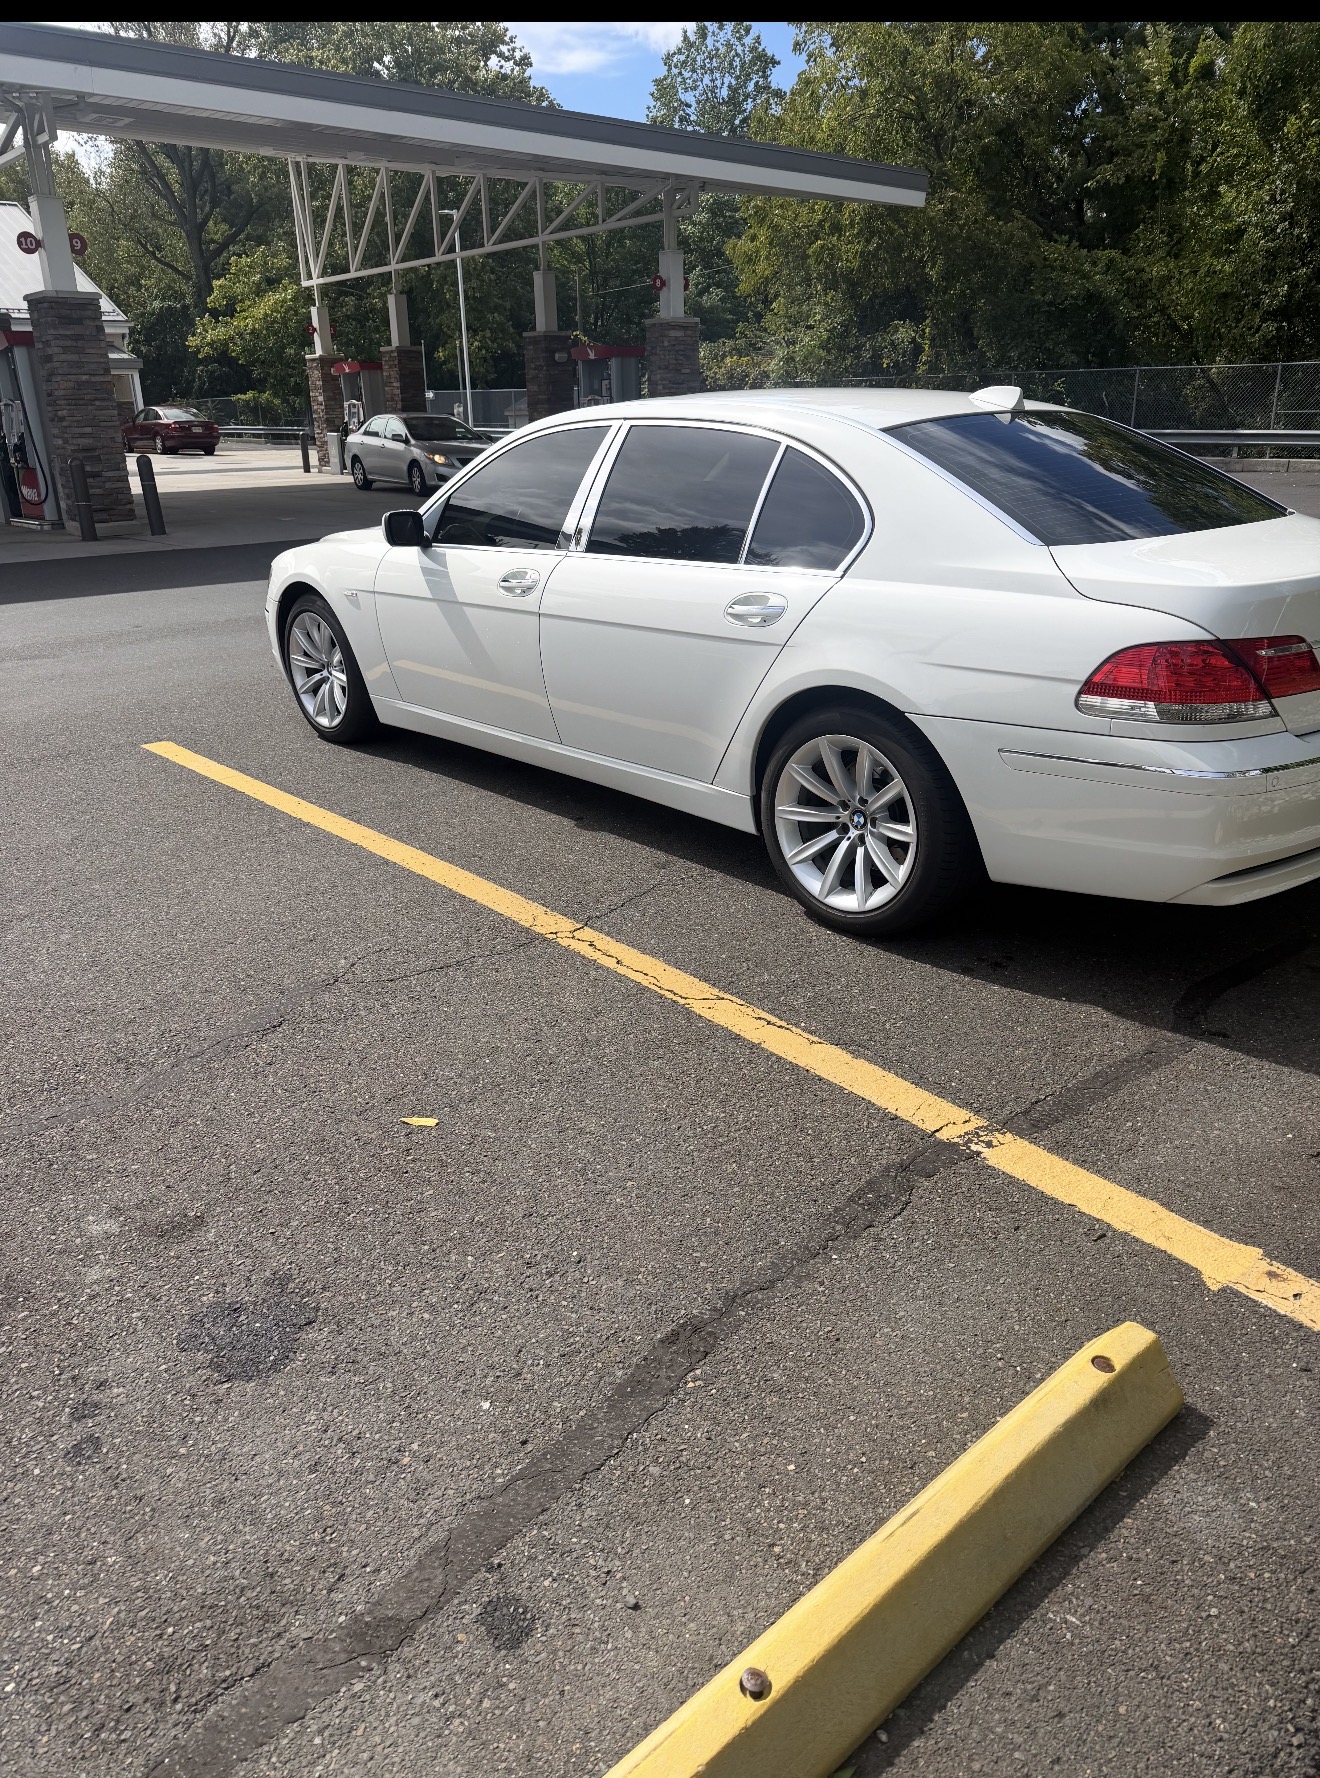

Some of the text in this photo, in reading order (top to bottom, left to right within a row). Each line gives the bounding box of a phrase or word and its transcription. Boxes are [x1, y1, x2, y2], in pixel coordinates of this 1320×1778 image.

[20, 238, 35, 249] 10
[72, 239, 81, 250] 9
[655, 279, 661, 287] 8
[21, 485, 38, 500] Wawa
